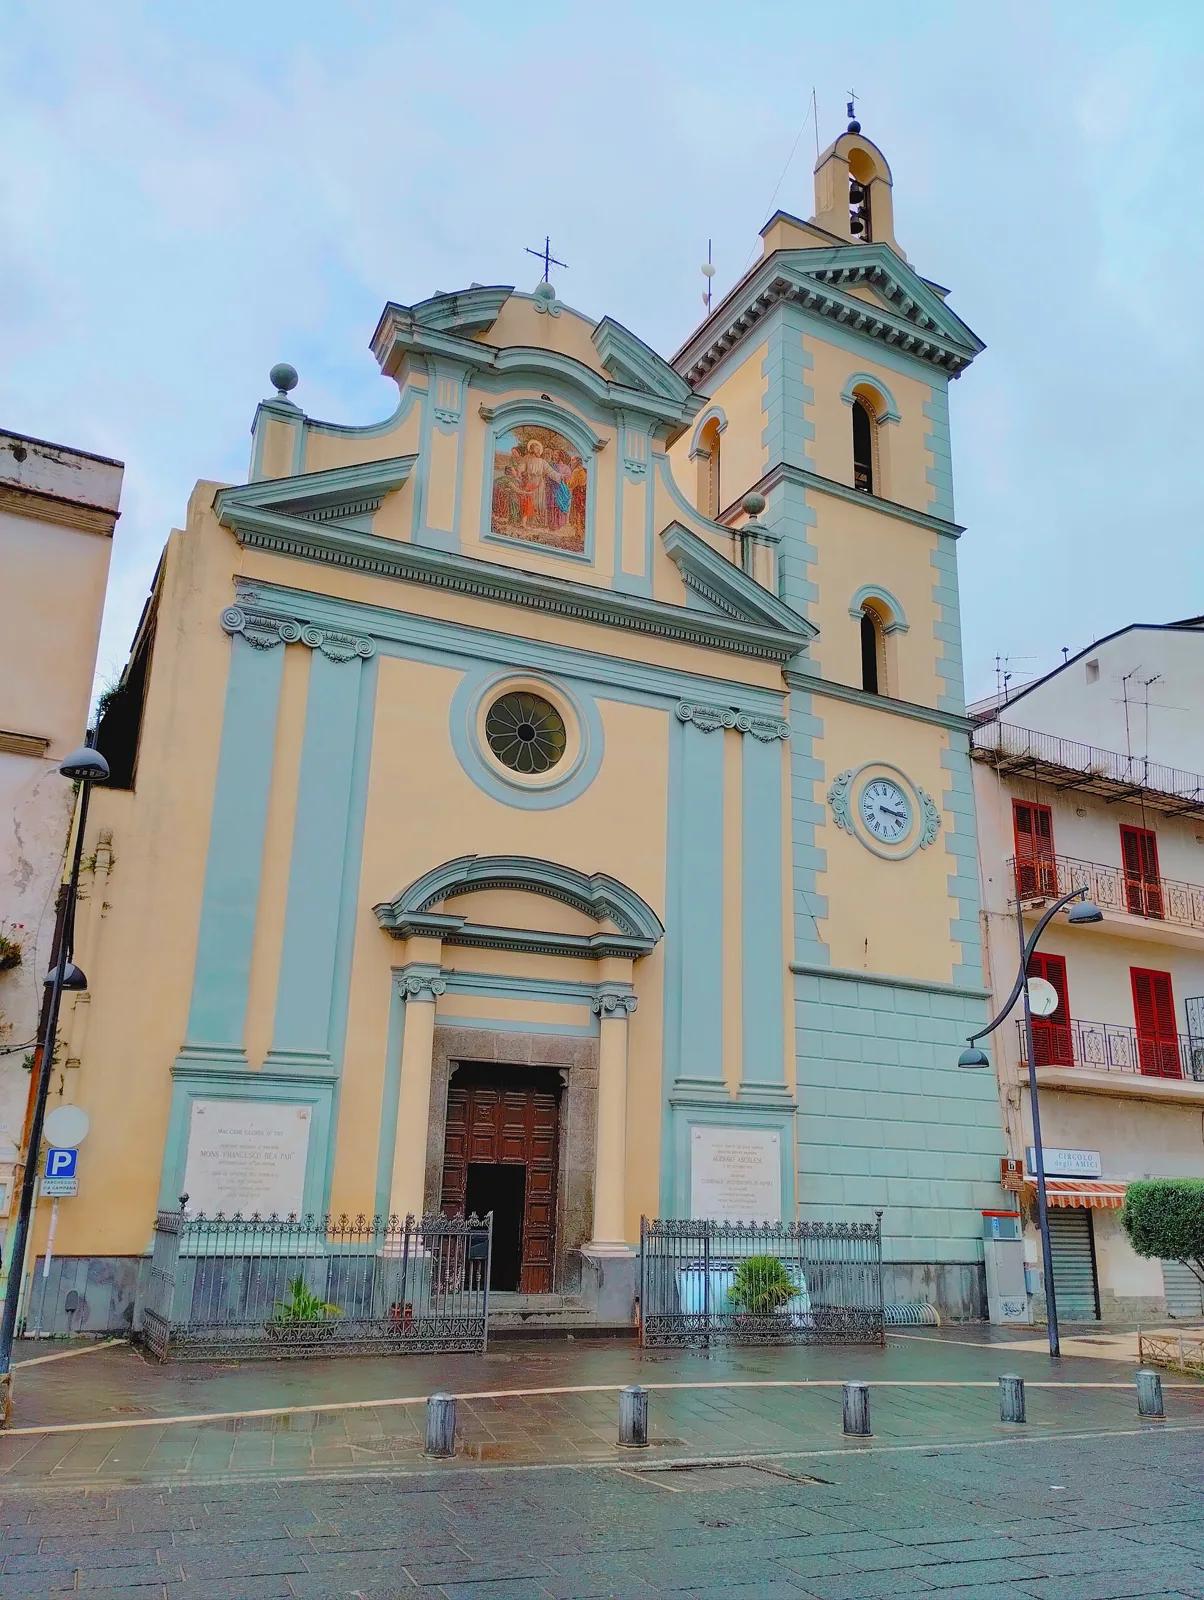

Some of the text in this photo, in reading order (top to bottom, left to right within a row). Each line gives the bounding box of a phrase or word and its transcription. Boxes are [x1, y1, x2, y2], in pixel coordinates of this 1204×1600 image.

[1058, 1153, 1093, 1161] CIRCOLO
[51, 1151, 72, 1175] P
[1054, 1160, 1072, 1168] degli
